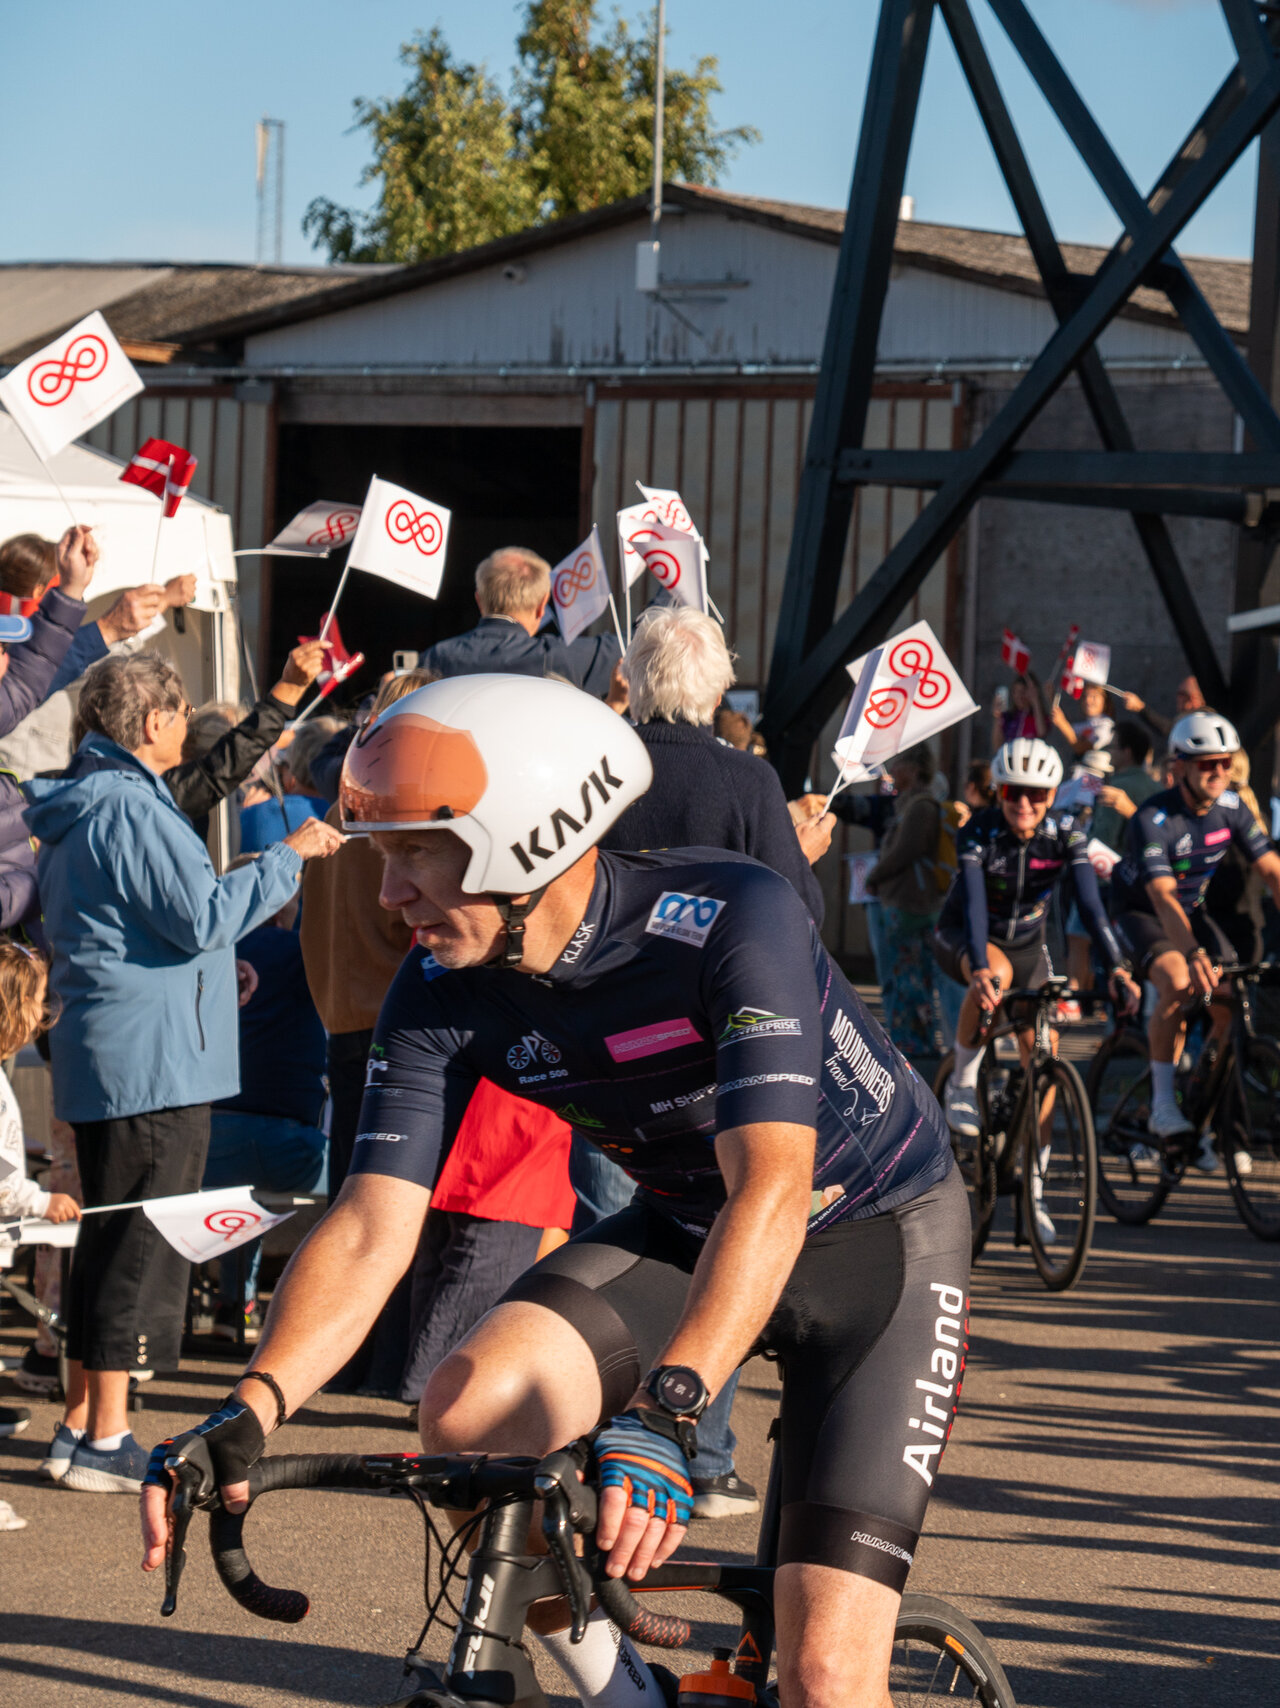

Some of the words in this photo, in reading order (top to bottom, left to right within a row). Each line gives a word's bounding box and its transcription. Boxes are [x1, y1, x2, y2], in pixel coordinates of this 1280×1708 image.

[510, 755, 624, 874] KASK
[561, 921, 596, 963] KLASK
[519, 1072, 547, 1084] Race
[549, 1069, 568, 1078] 500
[650, 1099, 674, 1114] MH
[829, 1009, 895, 1113] MOUNTAINEERS
[903, 1283, 963, 1487] Airland
[463, 1573, 496, 1679] FUJI
